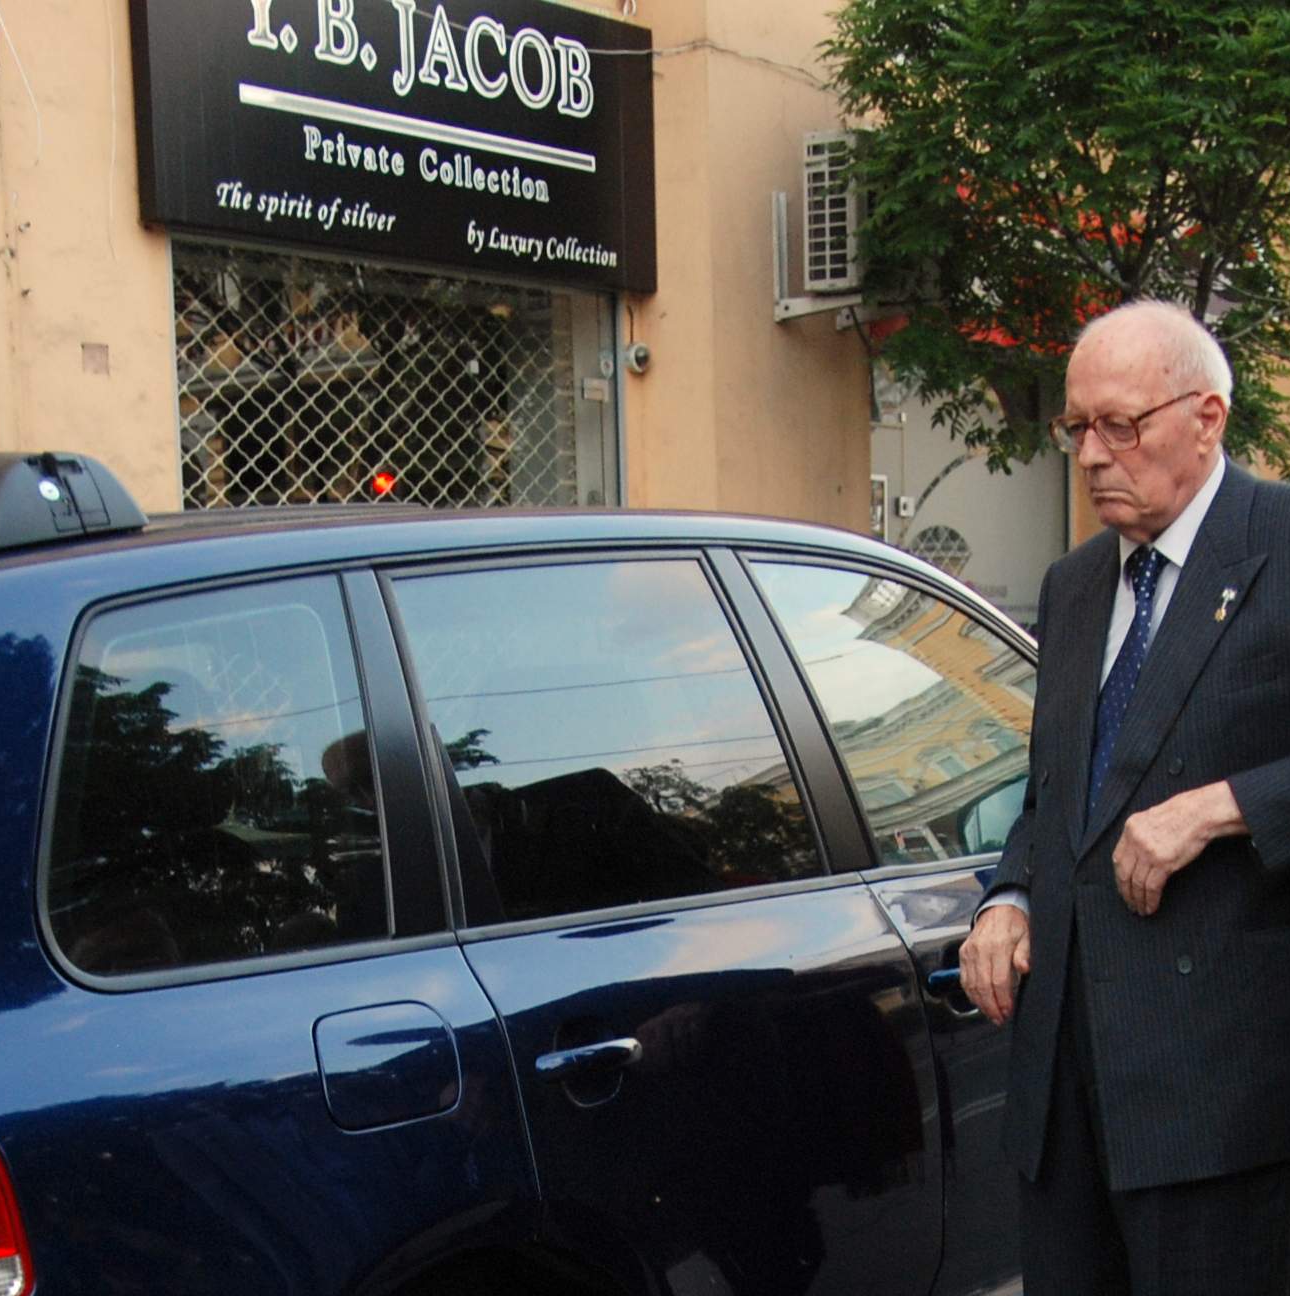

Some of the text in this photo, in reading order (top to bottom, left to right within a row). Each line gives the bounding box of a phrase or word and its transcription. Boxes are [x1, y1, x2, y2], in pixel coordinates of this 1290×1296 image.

[314, 0, 378, 72] B.
[392, 0, 594, 118] JACOB
[303, 124, 550, 203] Private Collection
[216, 181, 396, 232] The spirit of silver
[467, 220, 618, 268] by Luxury Collection
